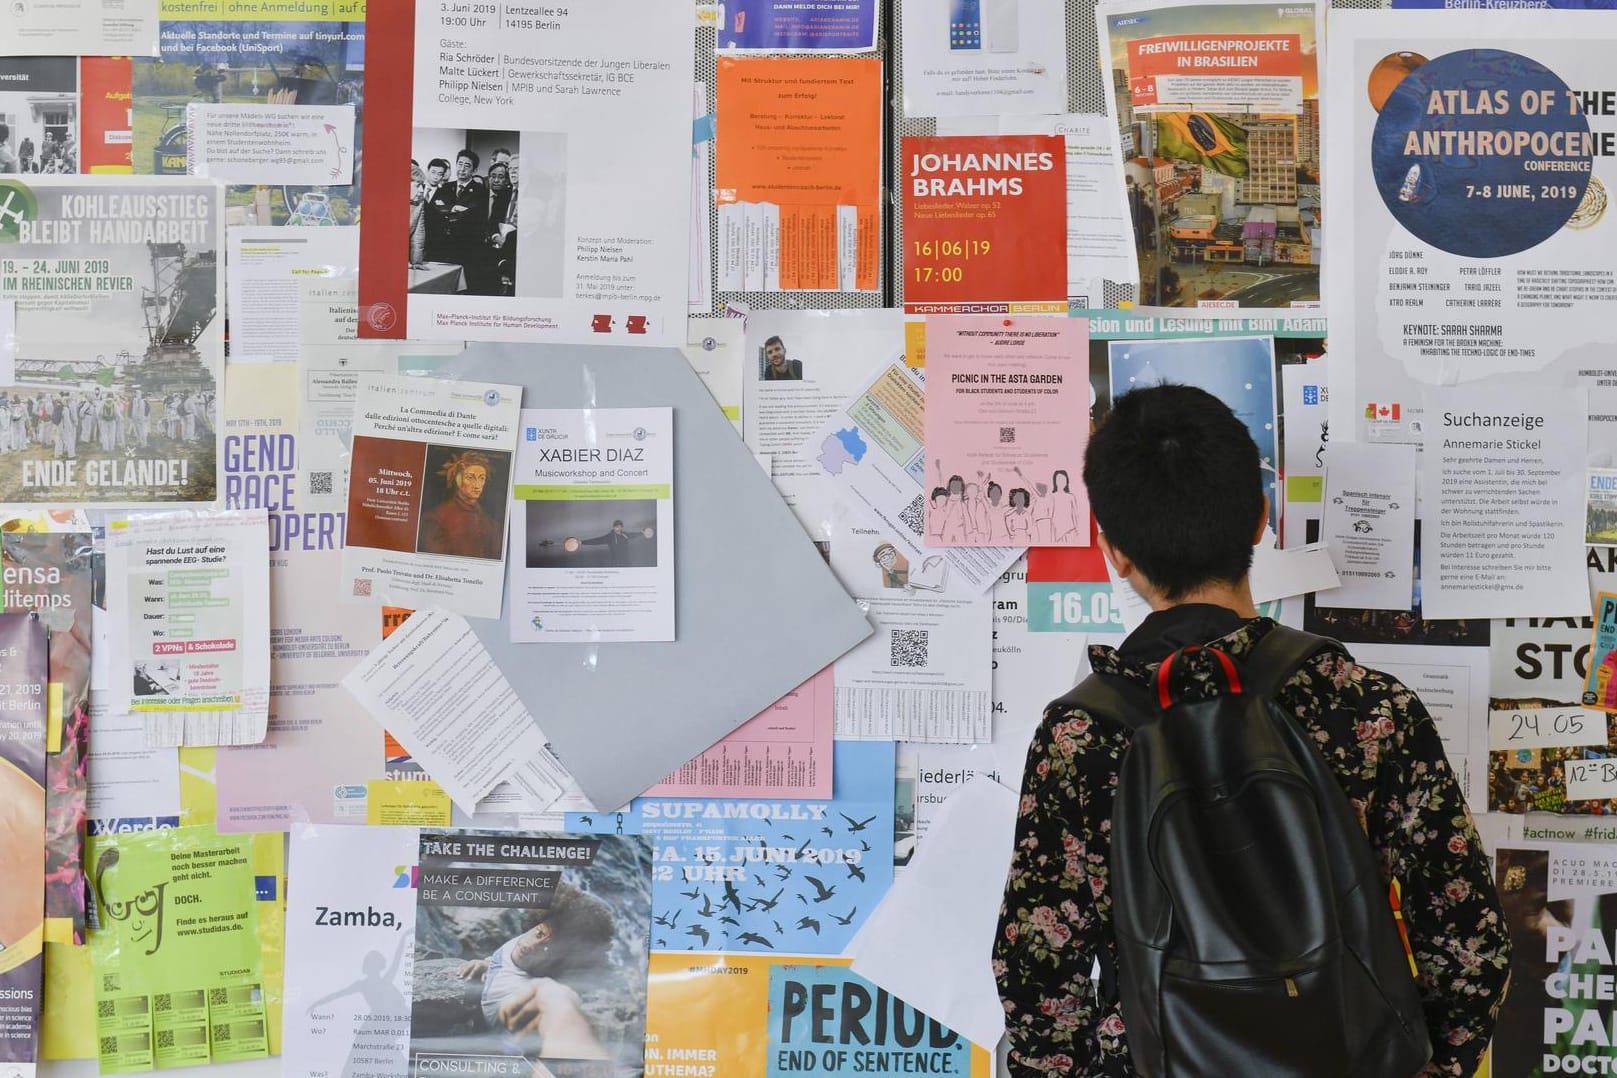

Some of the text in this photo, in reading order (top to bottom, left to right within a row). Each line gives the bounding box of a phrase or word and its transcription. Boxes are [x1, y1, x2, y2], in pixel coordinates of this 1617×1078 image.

[161, 2, 358, 17] kostenfrei ohne Anmeldung auf
[441, 3, 496, 14] 3. Juni 2019
[506, 5, 568, 18] Lentzeallee 94
[441, 17, 486, 27] 19:00 Uhr
[506, 19, 560, 30] 14195 Berlin
[161, 31, 365, 47] Aktuelle Standorte und Termine auf tinyurl.com
[440, 38, 467, 52] Gäste:
[161, 42, 284, 55] und bei Facebook (UniSport)
[1139, 39, 1289, 55] FREIWILLIGENPROJEKTE
[440, 52, 670, 72] Ria Schröder Bundesvorsitzende der Jungen Liberalen
[1177, 56, 1258, 67] IN BRASILIEN
[440, 66, 634, 83] Malte Lückert Gewerkschaftssekretär, IG BCE
[439, 80, 621, 96] Philipp Nielsen MPIB und Sarah Lawrence
[438, 94, 514, 106] College, New York
[1427, 91, 1616, 116] ATLAS OF THE
[1404, 131, 1616, 157] ANTHROPOCENE
[911, 153, 1053, 176] JOHANNES
[1525, 161, 1591, 173] CONFERENCE
[914, 178, 1023, 196] BRAHMS
[1466, 185, 1577, 202] 7-8 JUNE, 2019
[61, 195, 208, 218] KOHLEAUSSTIEG
[19, 221, 208, 244] BLEIBT HANDARBEIT
[3, 260, 109, 274] 19. 24. JUNI 2019
[1459, 267, 1501, 276] PETRA LÖFFLER
[915, 267, 962, 282] 17:00
[3, 277, 133, 290] IM RHEINISCHEN REVIER
[1418, 283, 1450, 291] STEININGER
[915, 304, 1060, 312] KAMMERCHOR BERLIN
[1403, 324, 1502, 336] KEYNOTE: SARAH SHARMA
[952, 374, 1063, 384] PICNIC IN THE ASTA GARDEN
[1444, 412, 1544, 431] Suchanzeige
[1443, 439, 1541, 450] Annemarie Stickel
[539, 448, 644, 462] XABIER DIAZ
[23, 460, 76, 486] ENDE
[378, 467, 413, 479] Mittwoch,
[534, 469, 598, 478] Musicworkshop
[380, 478, 394, 486] Juni
[226, 474, 296, 512] RACE
[165, 547, 176, 555] du
[194, 546, 208, 554] auf
[209, 546, 226, 554] eine
[146, 557, 182, 566] spannende
[642, 803, 827, 822] SUPAMOLLY
[1522, 826, 1576, 839] #actnow
[170, 847, 240, 861] Deine Masterarbeit
[421, 841, 590, 860] TAKE THE CHALLENGE!
[694, 847, 862, 865] 15. JUNI 2019
[172, 856, 248, 871] noch besser machen
[172, 870, 212, 884] geht nicht.
[424, 874, 554, 888] MAKE A DIFFERENCE.
[682, 866, 747, 882] UHR
[174, 894, 202, 905] DOCH.
[422, 889, 542, 902] BE A CONSULTANT.
[176, 917, 196, 927] Finde
[208, 914, 234, 923] heraus
[236, 911, 248, 920] auf
[315, 906, 403, 930] Zamba,
[177, 923, 244, 936] www.studidas.de.
[667, 1048, 717, 1061] IMMER
[418, 1060, 520, 1074] CONSULTING &
[778, 1050, 959, 1074] END OF SENTENCE.
